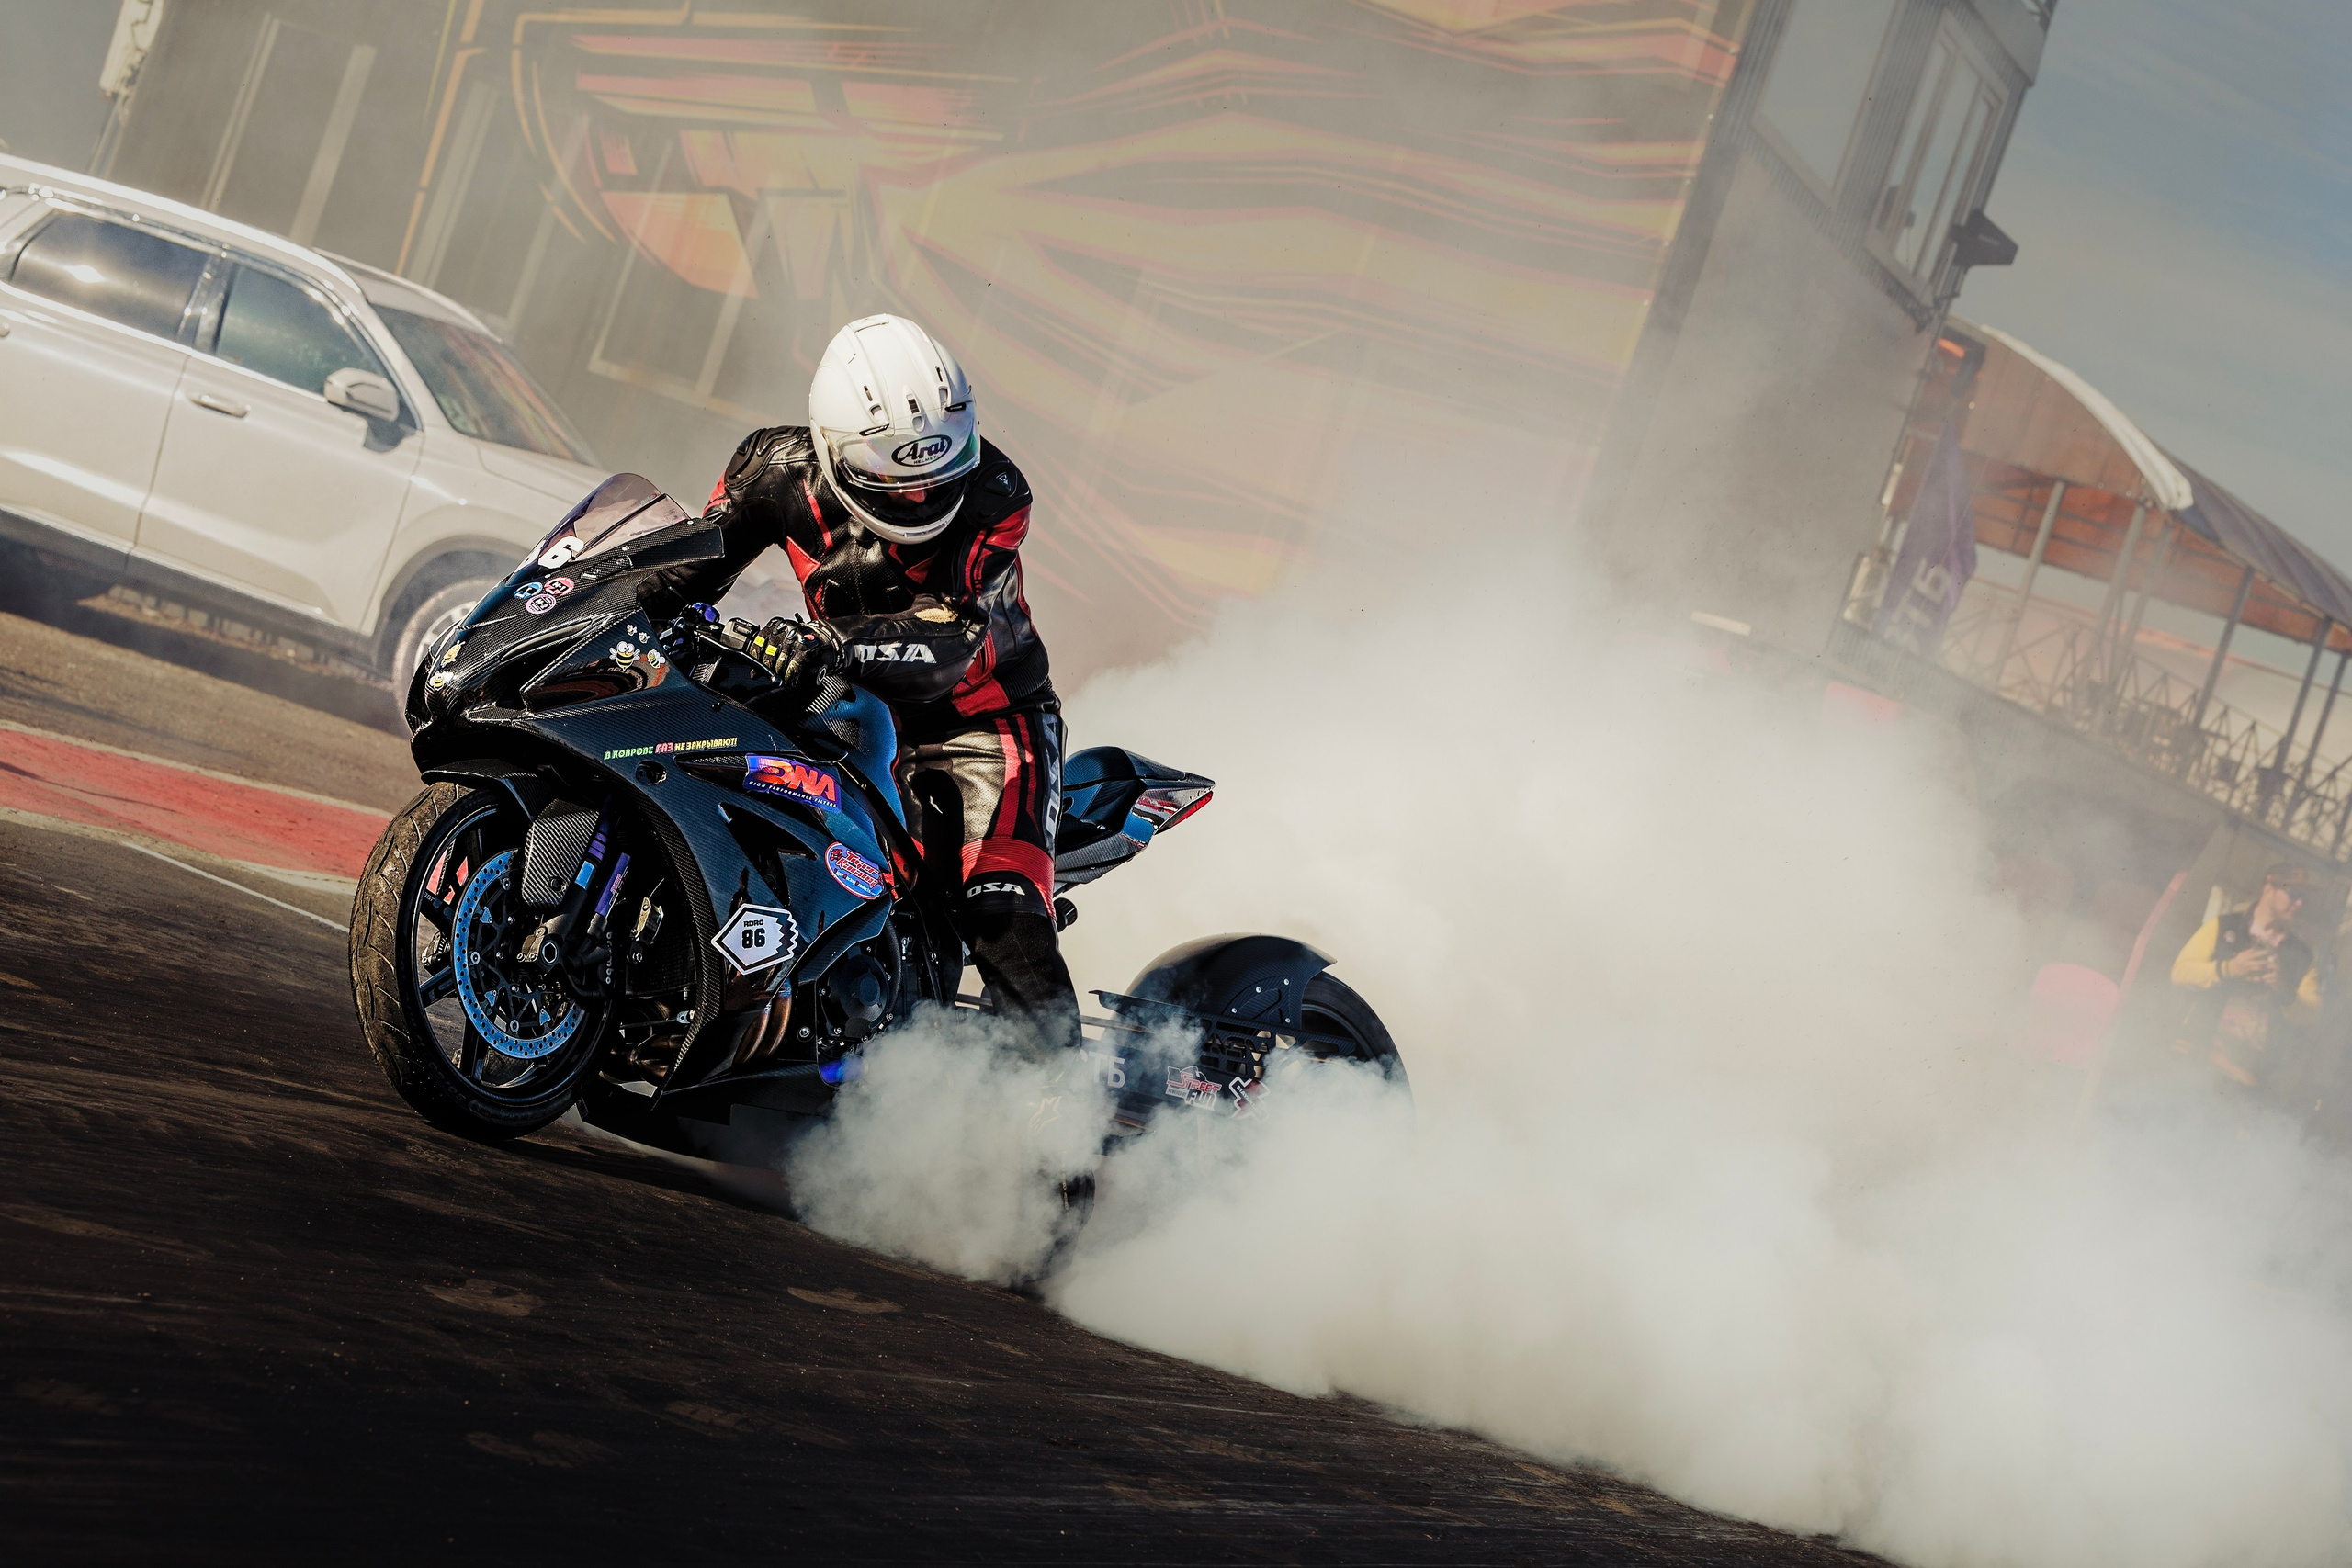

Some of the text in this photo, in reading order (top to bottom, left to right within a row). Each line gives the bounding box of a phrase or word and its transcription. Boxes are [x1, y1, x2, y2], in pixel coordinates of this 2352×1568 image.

[898, 437, 947, 461] Arai
[604, 737, 738, 760] В КОВРОВЕ ГАЗ НЕ ЗАКРЫВАЮТ!
[754, 758, 836, 802] DNA
[769, 784, 812, 801] PERFORMANCE
[814, 797, 837, 808] FILTERS
[742, 928, 765, 949] 86
[1167, 1072, 1222, 1093] STREET
